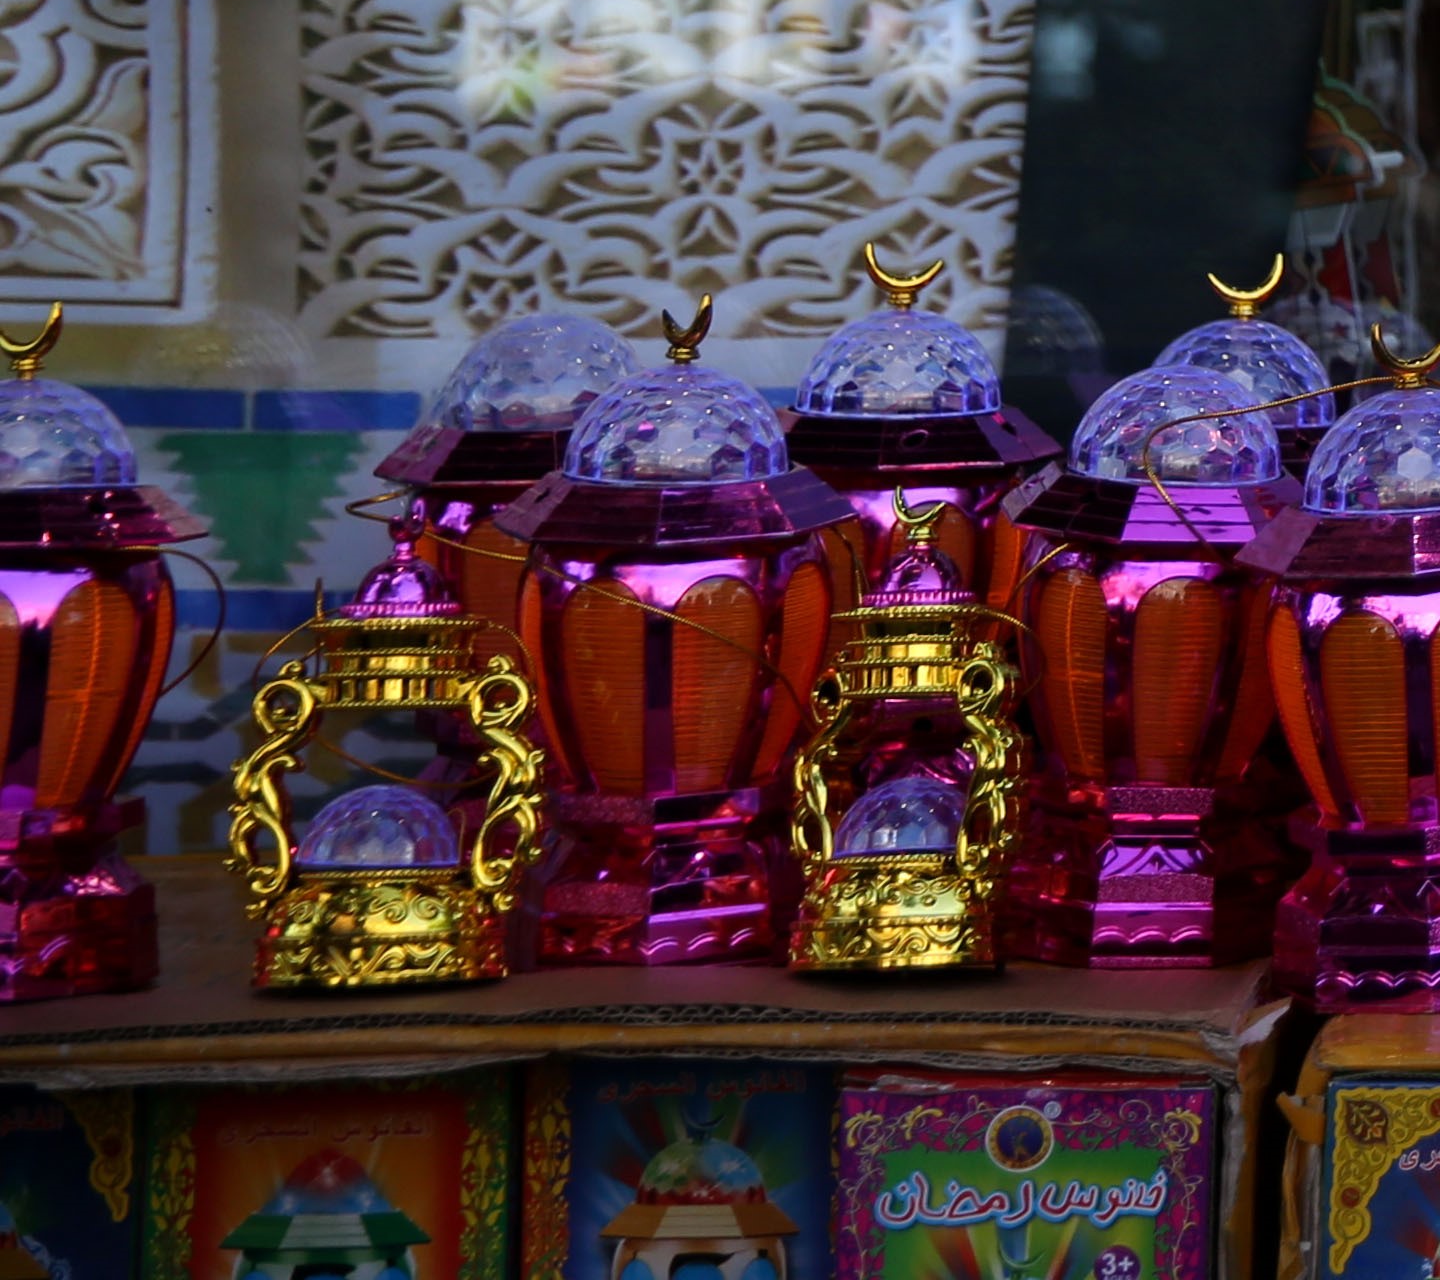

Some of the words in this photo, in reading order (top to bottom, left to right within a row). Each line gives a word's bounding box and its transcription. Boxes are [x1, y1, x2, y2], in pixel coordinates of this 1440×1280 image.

[876, 1171, 1035, 1228] رمضان
[1036, 1167, 1168, 1227] فانوس
[1101, 1252, 1135, 1275] 3+
